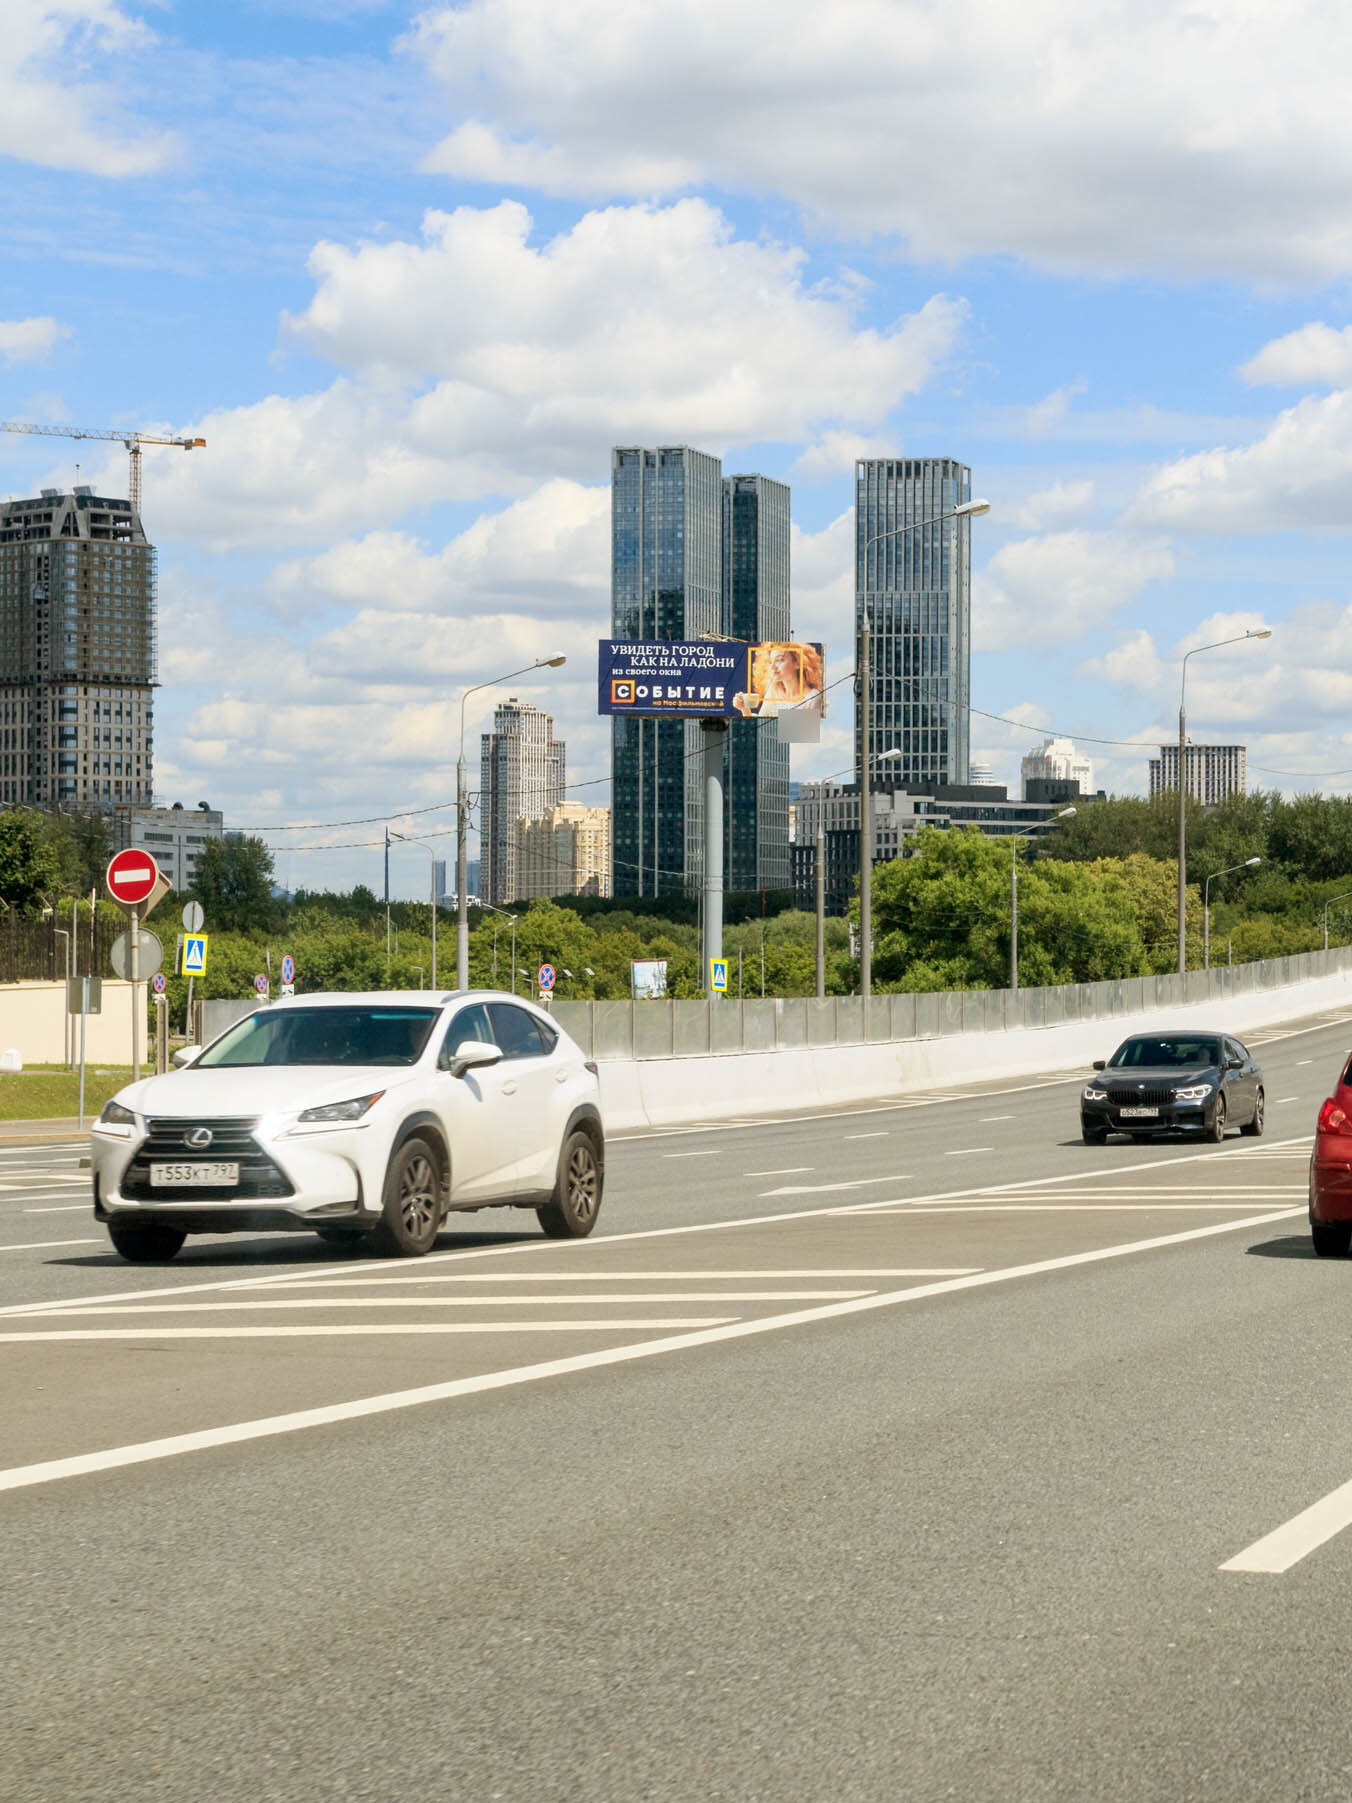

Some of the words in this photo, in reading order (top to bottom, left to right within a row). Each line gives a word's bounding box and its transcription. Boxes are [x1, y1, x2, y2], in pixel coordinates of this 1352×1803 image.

[611, 645, 670, 656] УВИДЕТЬ
[672, 646, 714, 657] ГОРОД
[631, 657, 657, 666] КАК
[660, 657, 678, 666] НА
[680, 657, 735, 669] ЛАДОНИ
[617, 685, 725, 699] СОБЫТИЕ
